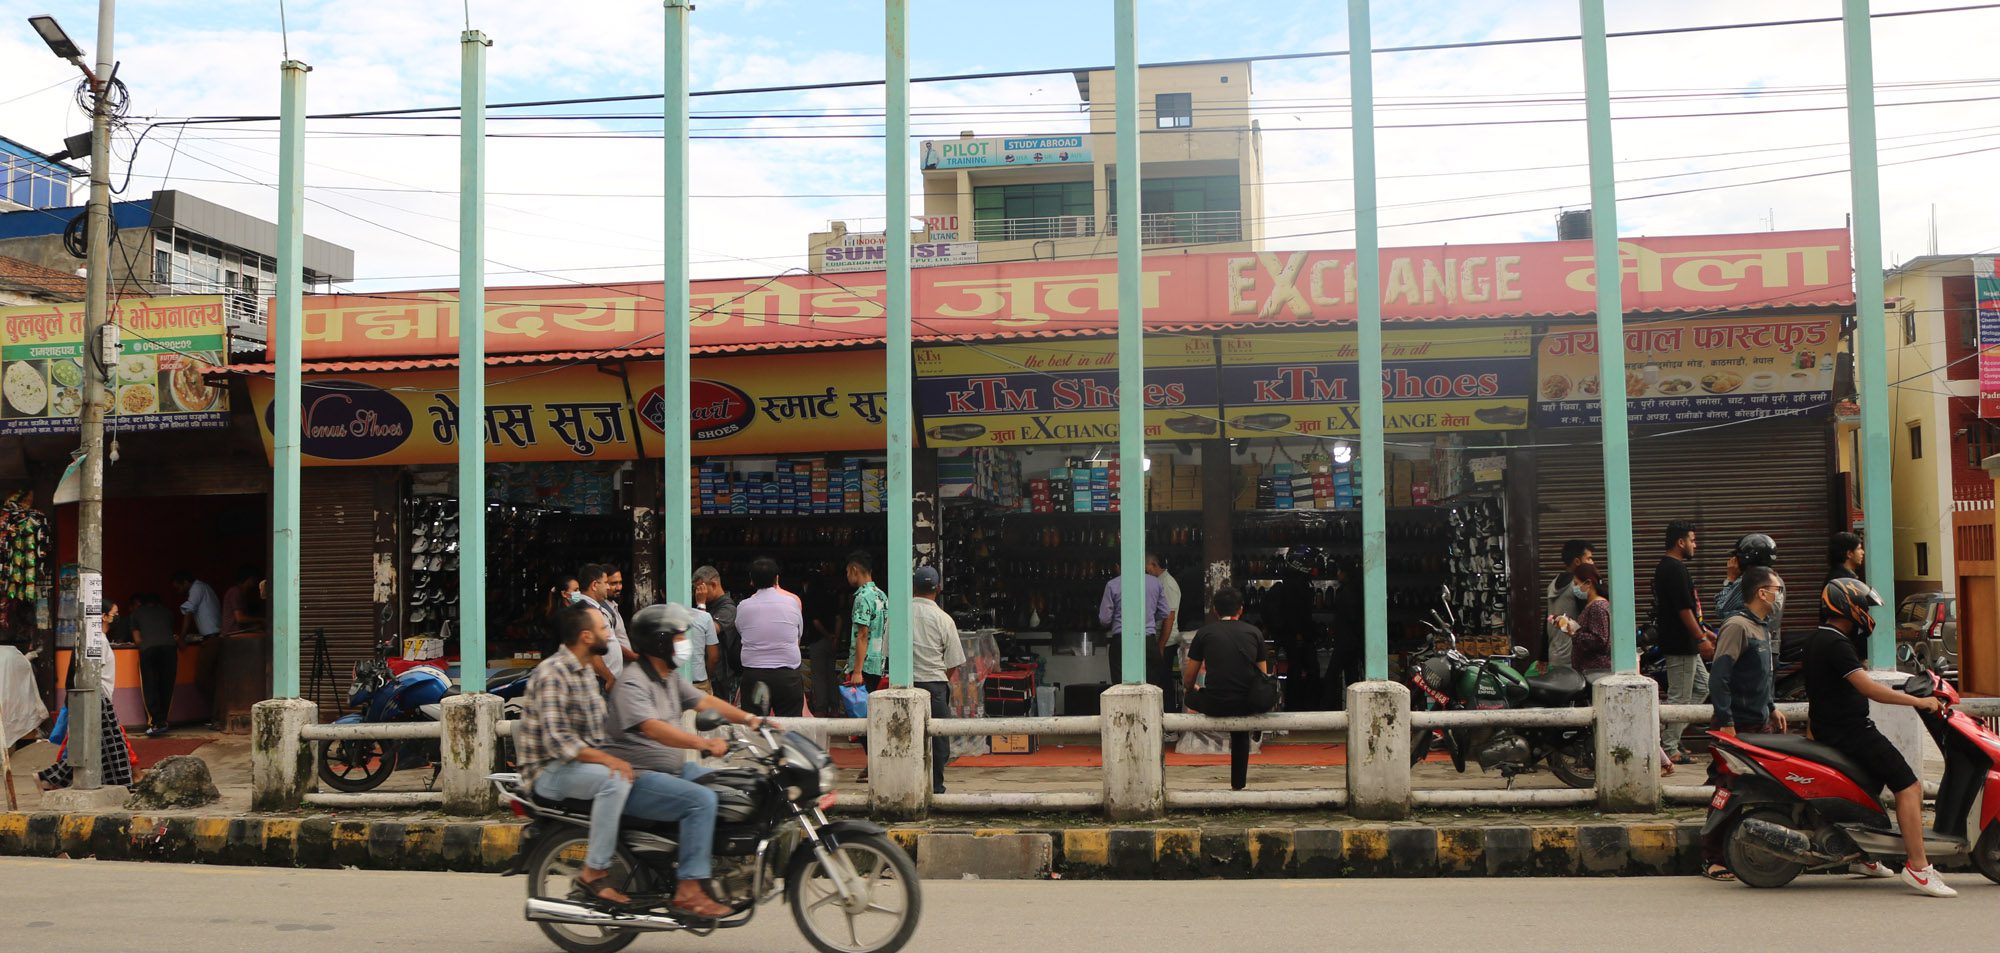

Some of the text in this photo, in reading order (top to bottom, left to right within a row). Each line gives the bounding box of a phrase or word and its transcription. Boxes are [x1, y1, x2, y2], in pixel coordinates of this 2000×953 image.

[943, 142, 989, 157] PILOT
[1008, 138, 1078, 150] STUDY ABROAD
[947, 156, 987, 165] TRAINING
[825, 243, 951, 261] SUNSE
[856, 236, 886, 246] INDO-W
[1563, 242, 1840, 292] मेला
[6, 306, 64, 342] बुलबुले
[130, 301, 223, 331] भोजनालय
[1392, 344, 1405, 356] in
[1409, 342, 1432, 355] all
[1548, 319, 1832, 356] जयवाल फास्टफुड
[1024, 352, 1115, 368] the best in all
[946, 377, 1038, 413] KTM
[1253, 367, 1499, 402] KTM Shoes
[301, 393, 403, 438] Venus Shoes
[650, 397, 740, 424] Sart
[1327, 406, 1438, 431] EXANGE
[698, 424, 739, 439] SHOES
[1021, 416, 1121, 440] EXCHANG
